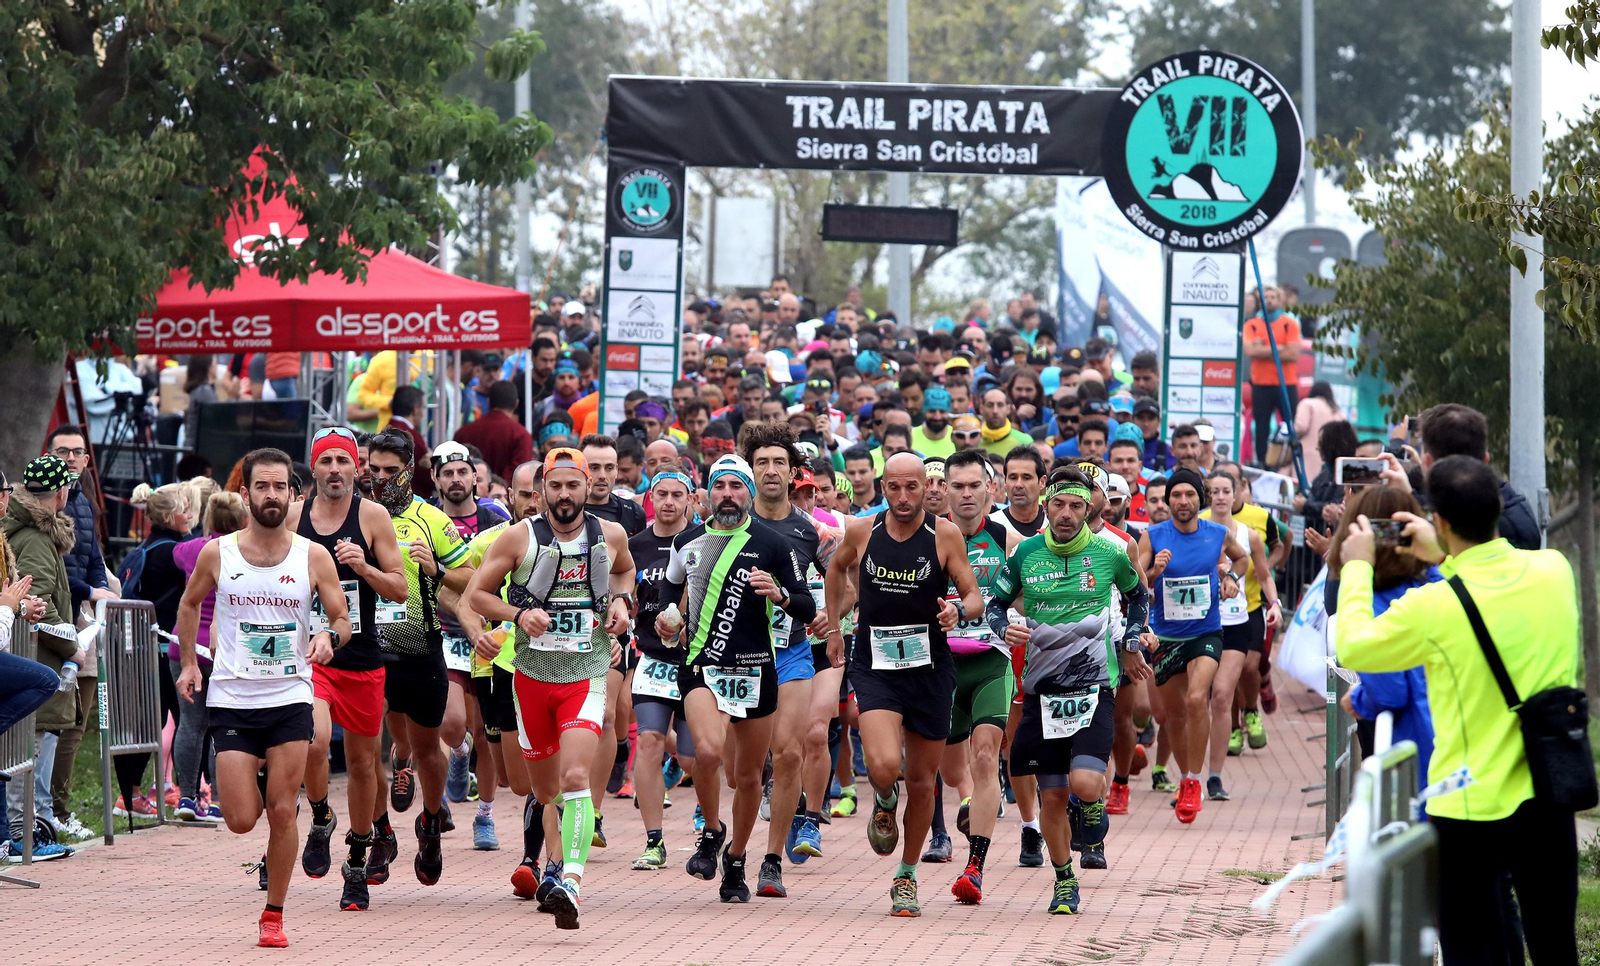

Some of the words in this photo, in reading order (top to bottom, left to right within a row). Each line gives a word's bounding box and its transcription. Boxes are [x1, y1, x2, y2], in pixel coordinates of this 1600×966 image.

[1120, 58, 1190, 107] TRAIL
[1198, 55, 1282, 113] PIRATA
[786, 95, 896, 131] TRAIL
[909, 99, 1051, 135] PIRATA
[1157, 94, 1248, 157] VII
[796, 137, 868, 160] Sierra
[877, 139, 922, 162] San
[930, 141, 1039, 165] Cristóbal
[635, 181, 658, 198] VII
[1180, 204, 1217, 219] 2018
[1125, 203, 1166, 240] Sierra
[1169, 232, 1198, 248] San
[1183, 290, 1229, 301] INAUTO
[135, 309, 272, 348] sport.es
[316, 303, 500, 345] alssport.es
[618, 328, 665, 340] INAUTO
[162, 340, 198, 348] RUNNING
[205, 339, 228, 348] TRAIL
[233, 339, 272, 347] OUTDOOR
[390, 336, 427, 344] RUNNING
[432, 334, 455, 343] TRAIL
[461, 334, 500, 342] OUTDOOR
[877, 566, 916, 582] David
[1026, 576, 1038, 584] RUN
[1039, 574, 1045, 582] &
[1046, 571, 1065, 580] TRAIL
[1079, 571, 1088, 588] chili
[228, 593, 300, 609] FUNDADOR
[1179, 588, 1195, 605] 71
[546, 612, 582, 633] 551
[704, 567, 751, 661] fisiobahía
[261, 636, 275, 658] 4
[897, 640, 905, 660] 1
[643, 661, 678, 683] 436
[716, 679, 748, 699] 316
[1049, 698, 1090, 719] 206
